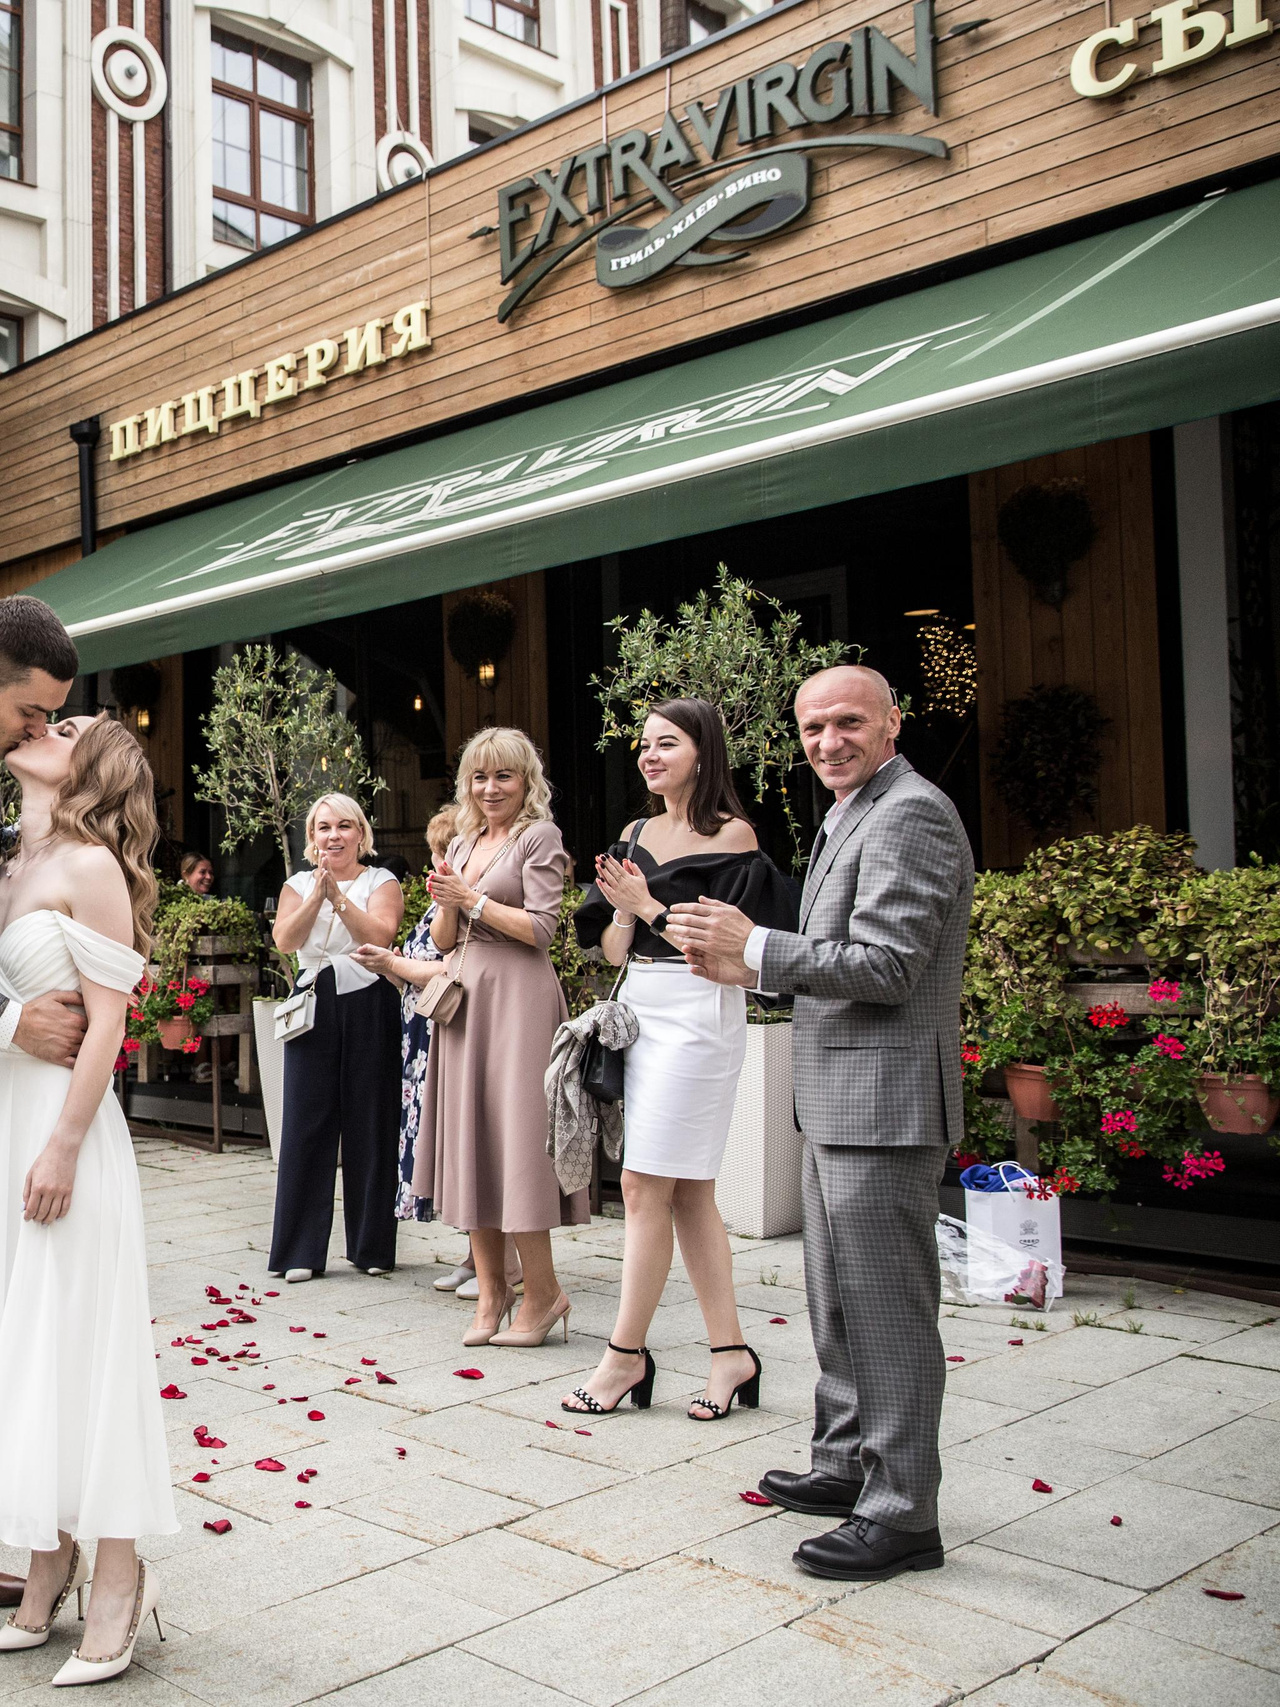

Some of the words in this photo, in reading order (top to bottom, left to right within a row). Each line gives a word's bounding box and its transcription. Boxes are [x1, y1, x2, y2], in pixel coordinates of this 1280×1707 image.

[610, 237, 666, 271] ГРИЛЬ
[671, 194, 719, 239] ХЛЕБ
[725, 168, 782, 199] ВИНО
[109, 301, 432, 461] ПИЦЦЕРИЯ
